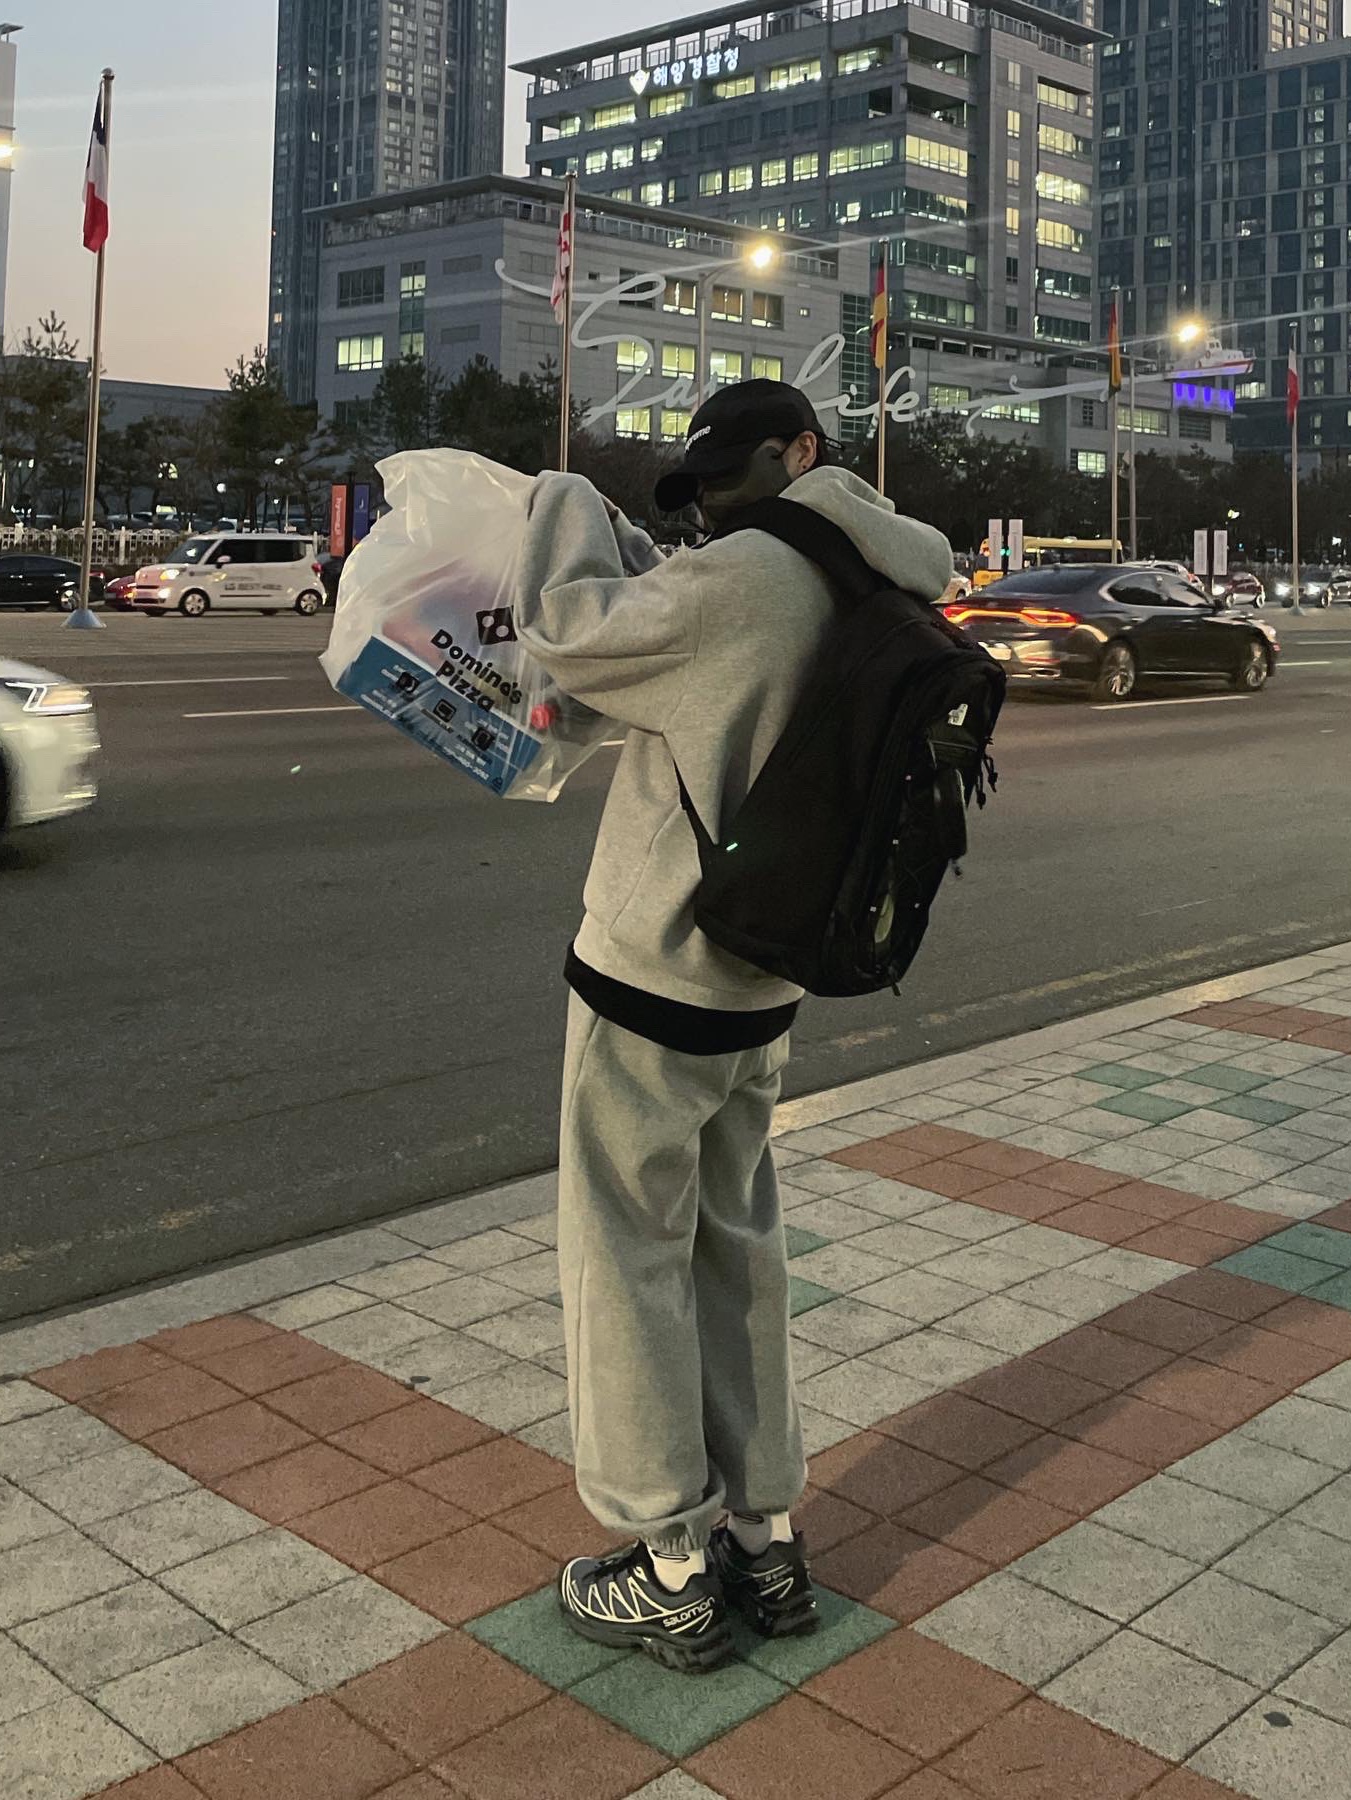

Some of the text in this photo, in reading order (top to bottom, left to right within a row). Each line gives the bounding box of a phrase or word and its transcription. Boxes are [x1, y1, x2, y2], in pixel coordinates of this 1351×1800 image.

[653, 47, 739, 87] 해양경찰청
[430, 629, 522, 705] Domino's
[435, 660, 496, 713] Pizza
